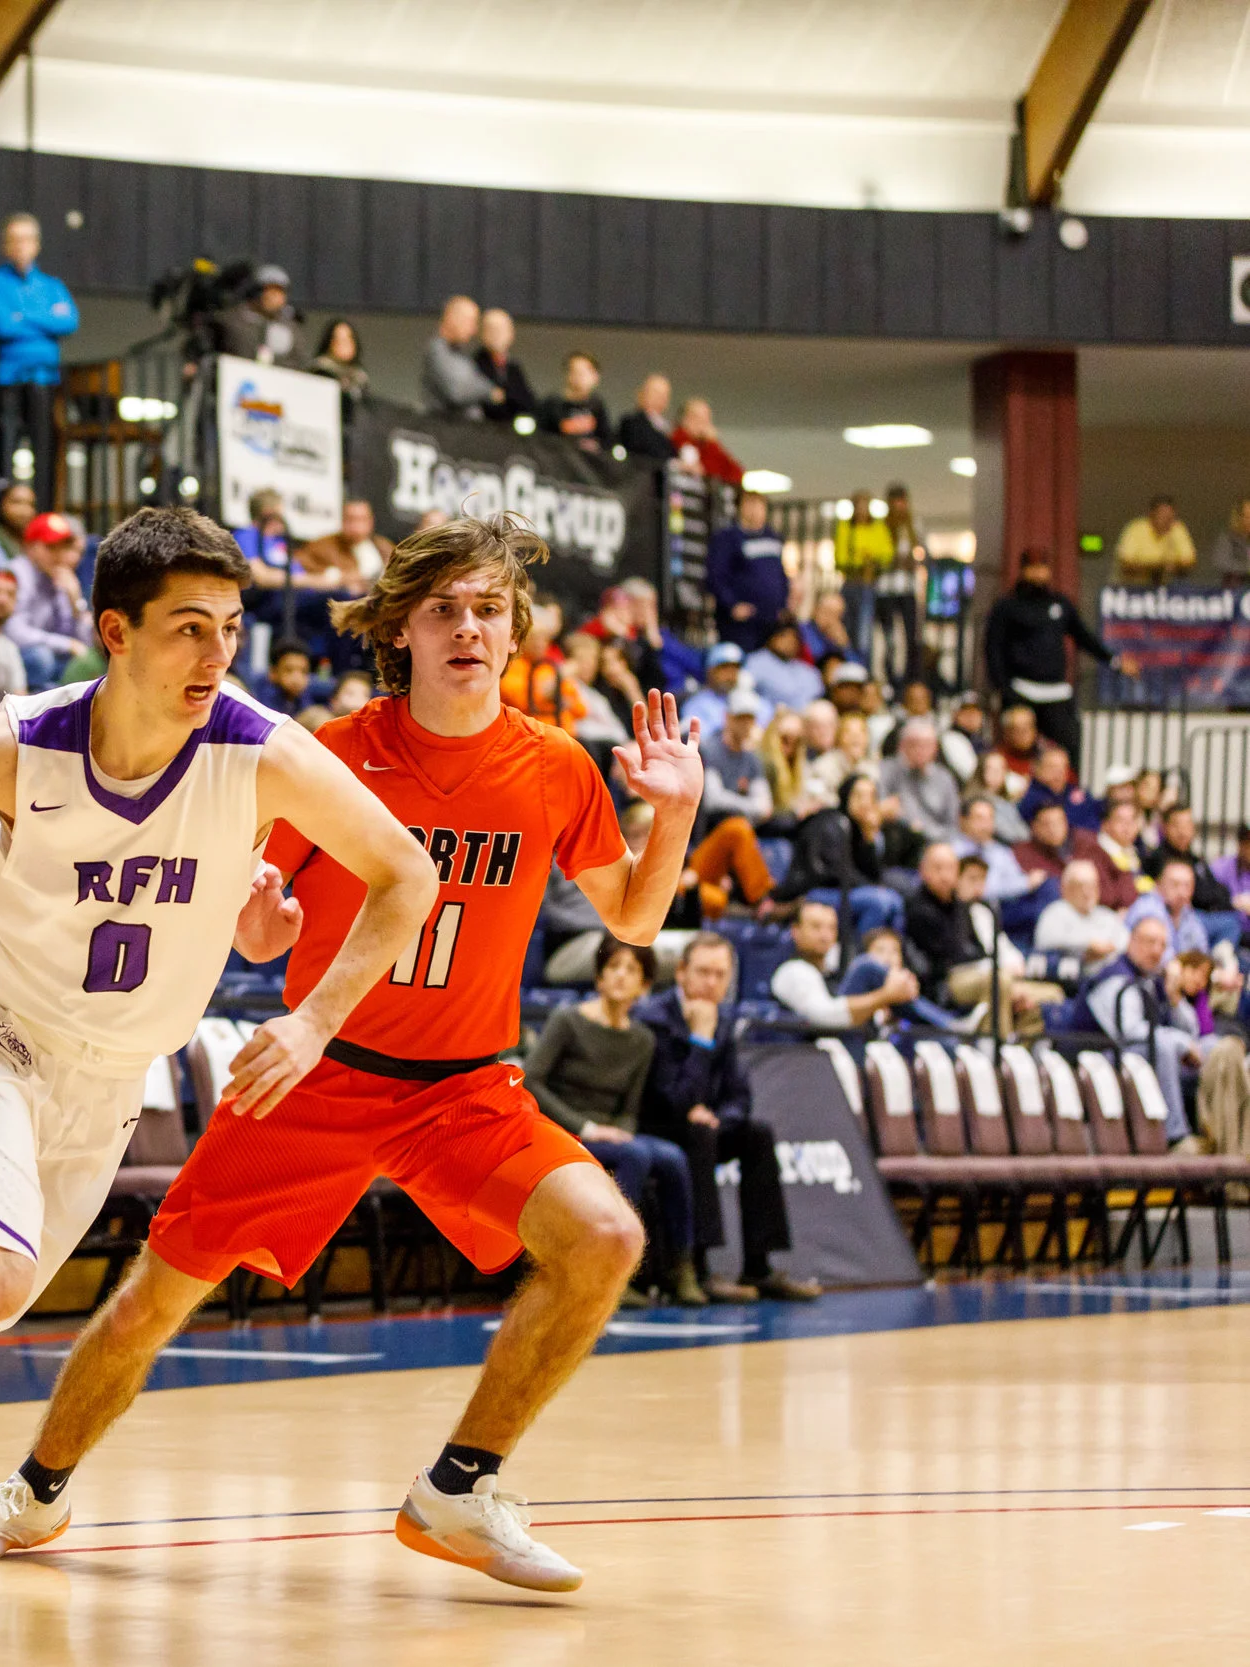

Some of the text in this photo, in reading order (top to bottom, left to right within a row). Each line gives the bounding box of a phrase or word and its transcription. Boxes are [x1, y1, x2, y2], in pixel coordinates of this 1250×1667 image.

[1102, 587, 1234, 621] National
[73, 855, 198, 906] RFH
[406, 825, 523, 887] RTH
[82, 919, 152, 993] 0
[388, 901, 466, 989] 11
